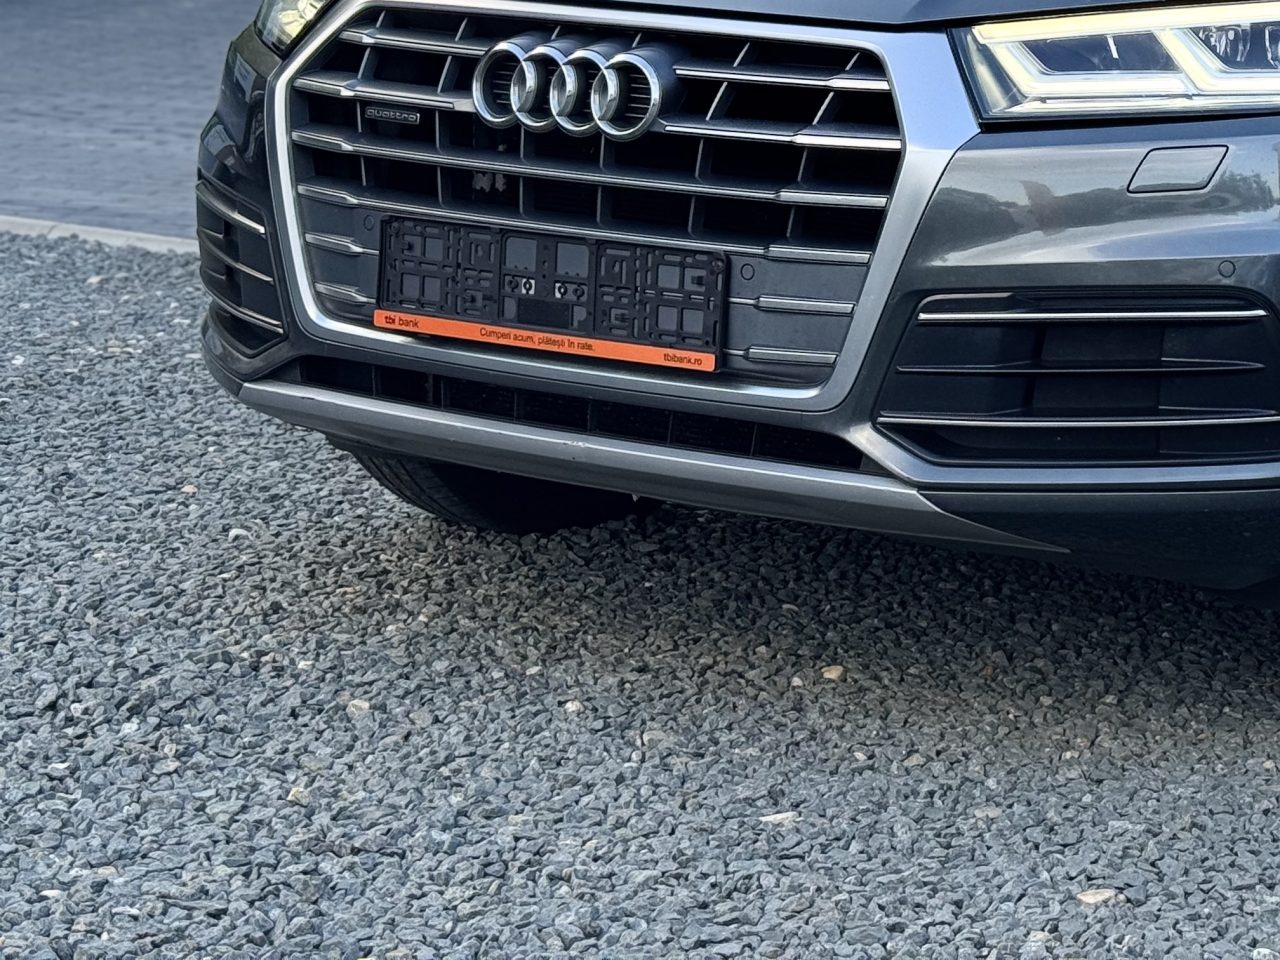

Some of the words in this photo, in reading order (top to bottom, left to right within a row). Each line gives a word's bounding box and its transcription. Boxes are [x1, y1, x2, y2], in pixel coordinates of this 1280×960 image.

[366, 108, 417, 123] quattro
[398, 315, 420, 329] bank
[663, 352, 703, 367] tbibank.ro
